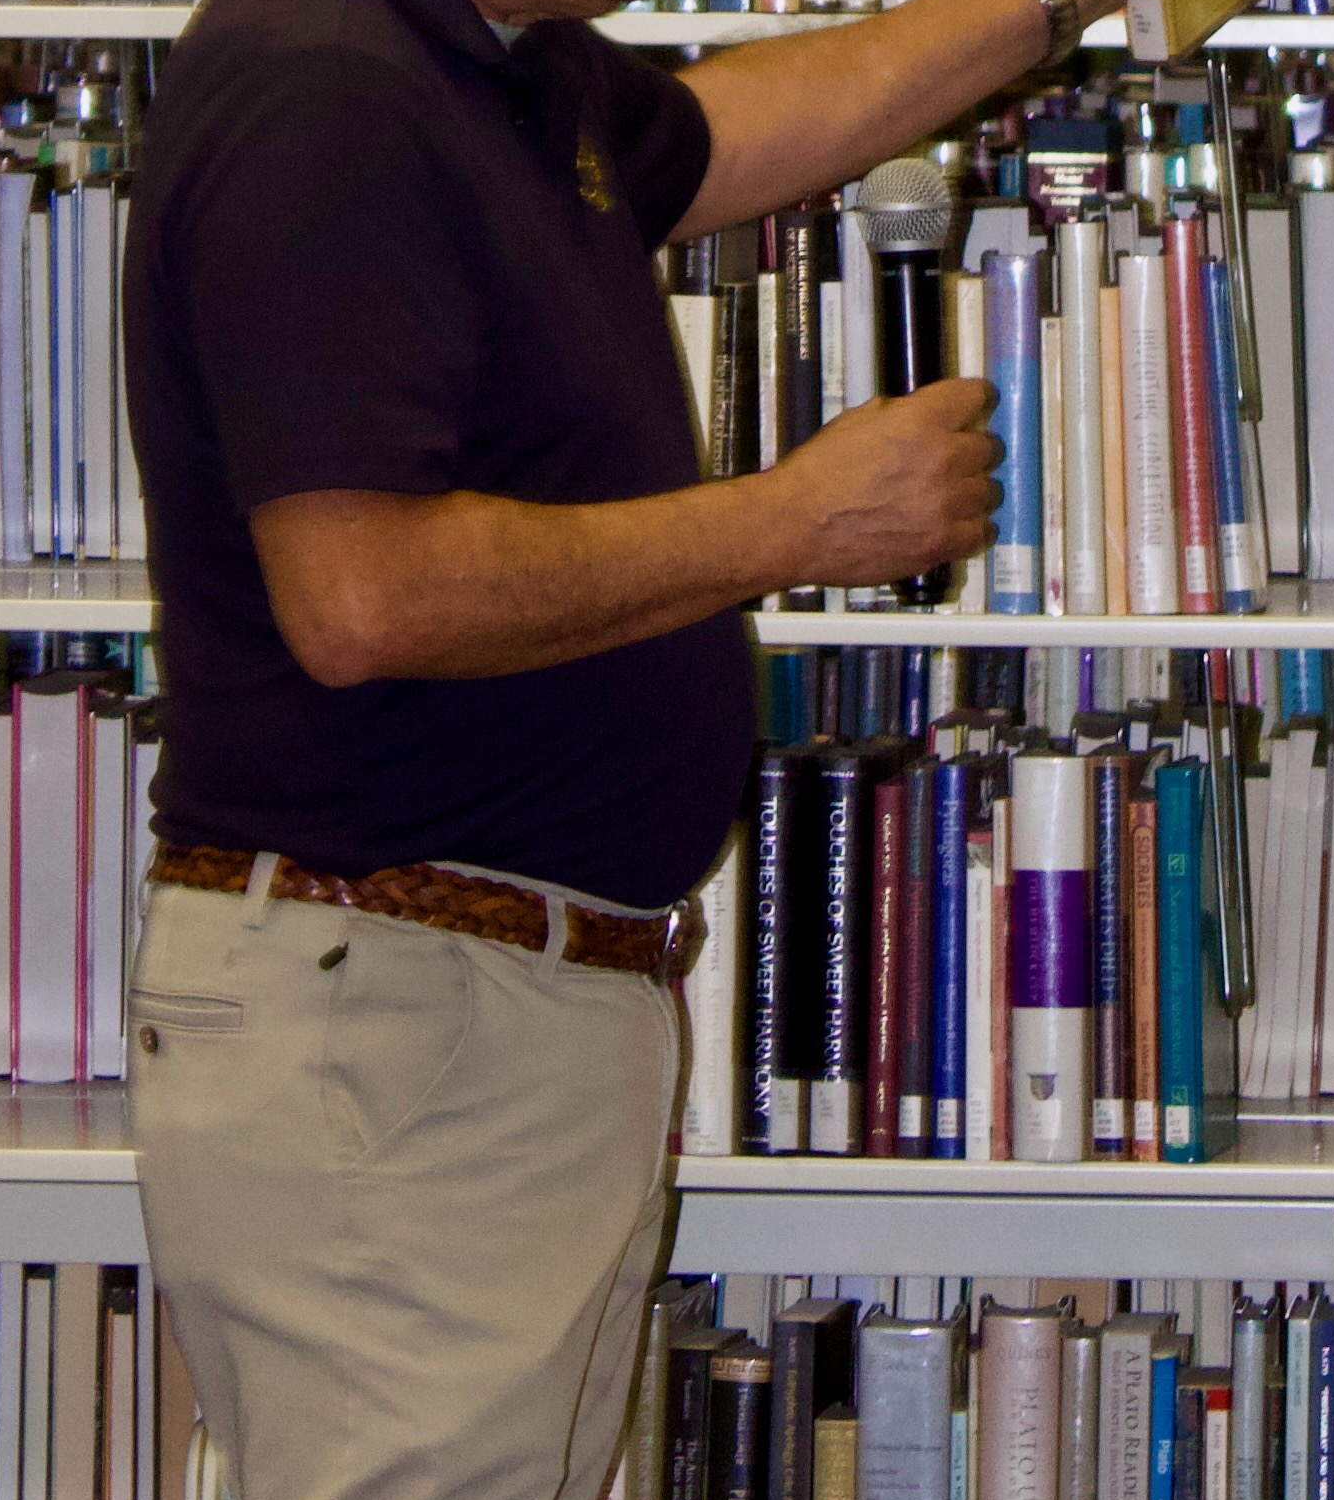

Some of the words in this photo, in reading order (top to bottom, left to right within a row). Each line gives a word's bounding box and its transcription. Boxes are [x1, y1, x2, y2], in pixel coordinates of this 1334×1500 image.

[759, 796, 778, 893] TOUCHES
[940, 800, 959, 886] Pythagoras
[1137, 835, 1150, 909] SOCRATES
[758, 899, 775, 926] OF
[756, 932, 774, 1002] SWEET
[753, 1009, 772, 1116] HARMONY
[1126, 1350, 1141, 1362] A
[1018, 1388, 1038, 1475] PLATO
[1124, 1370, 1141, 1431] PLATO
[1157, 1439, 1169, 1474] Plato
